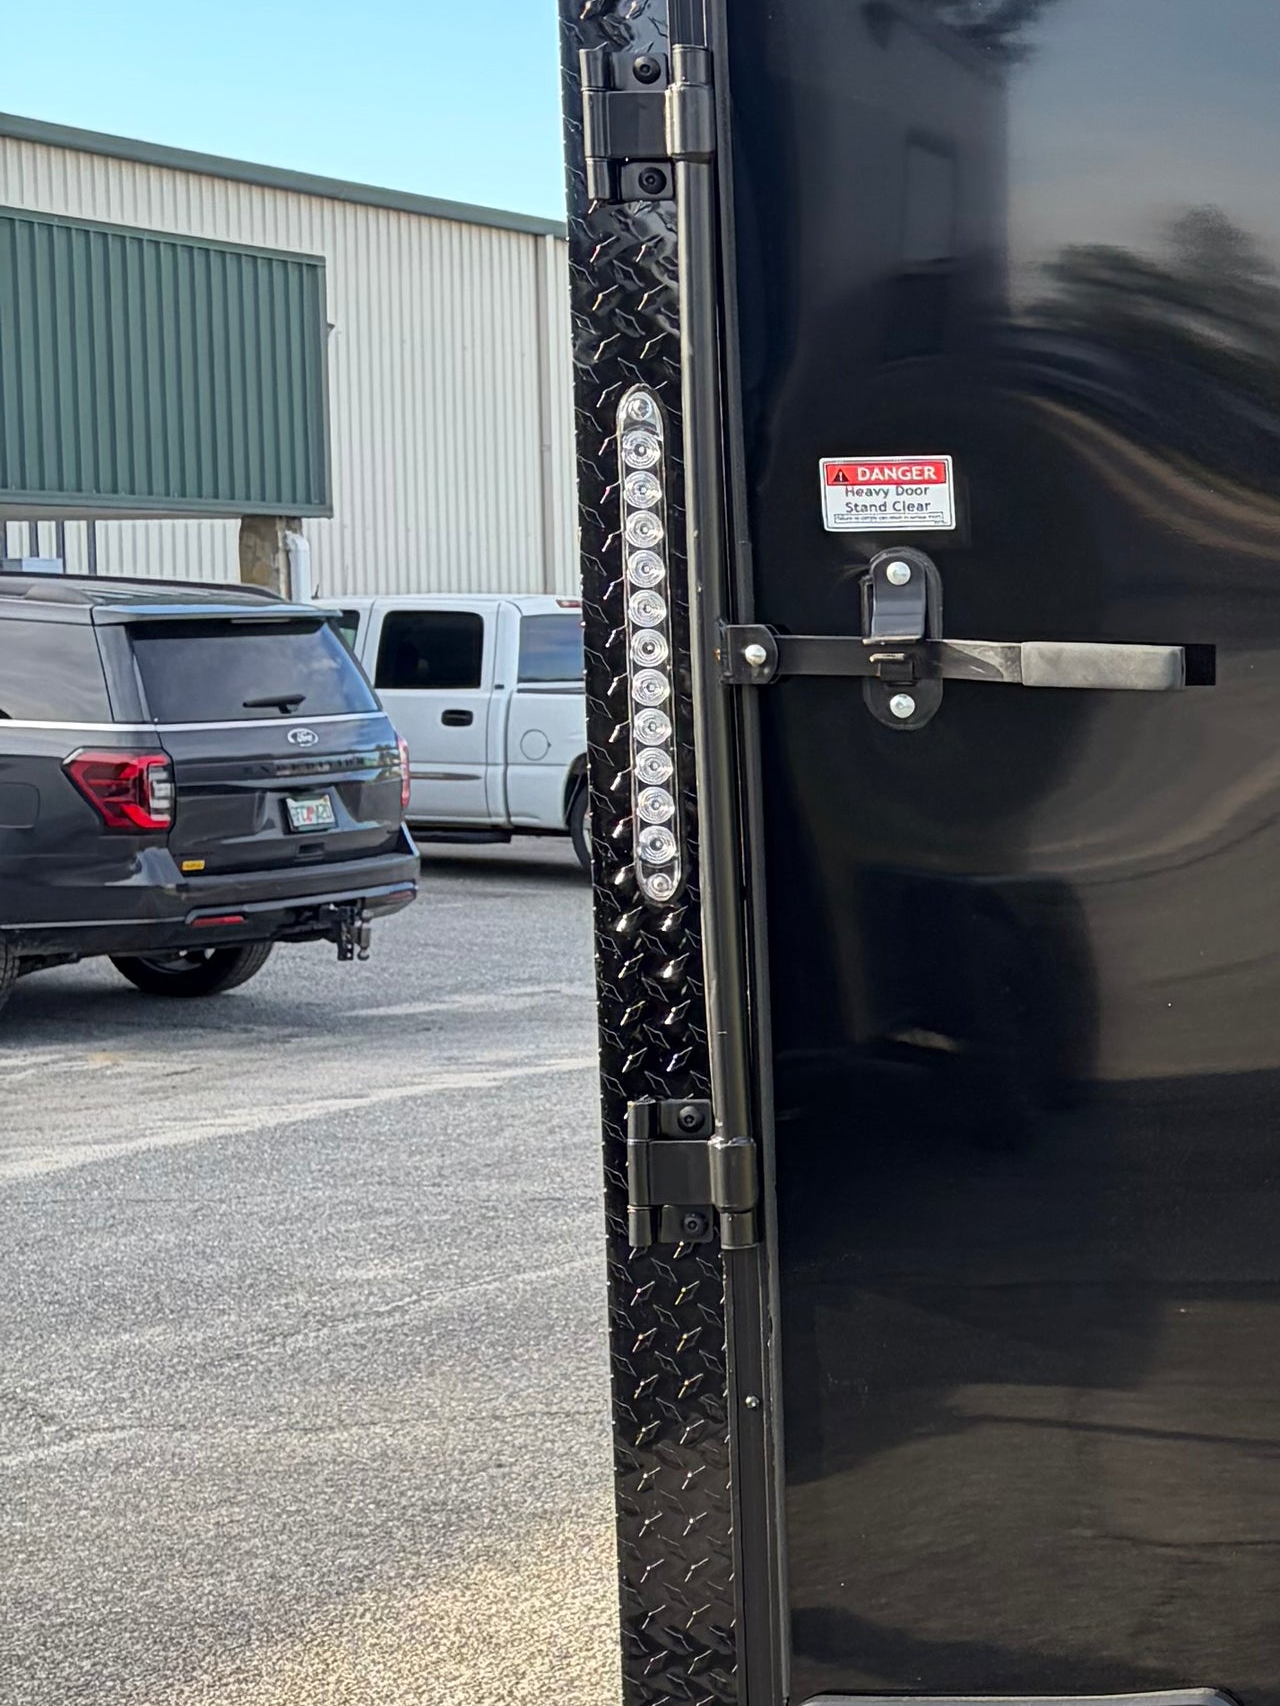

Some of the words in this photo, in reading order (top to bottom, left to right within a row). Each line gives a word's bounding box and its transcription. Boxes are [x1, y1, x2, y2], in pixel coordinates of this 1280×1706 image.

[857, 465, 937, 482] DANGER
[845, 485, 890, 499] Heavy
[895, 485, 930, 497] Door
[845, 501, 888, 513] Stand
[892, 500, 932, 512] Clear
